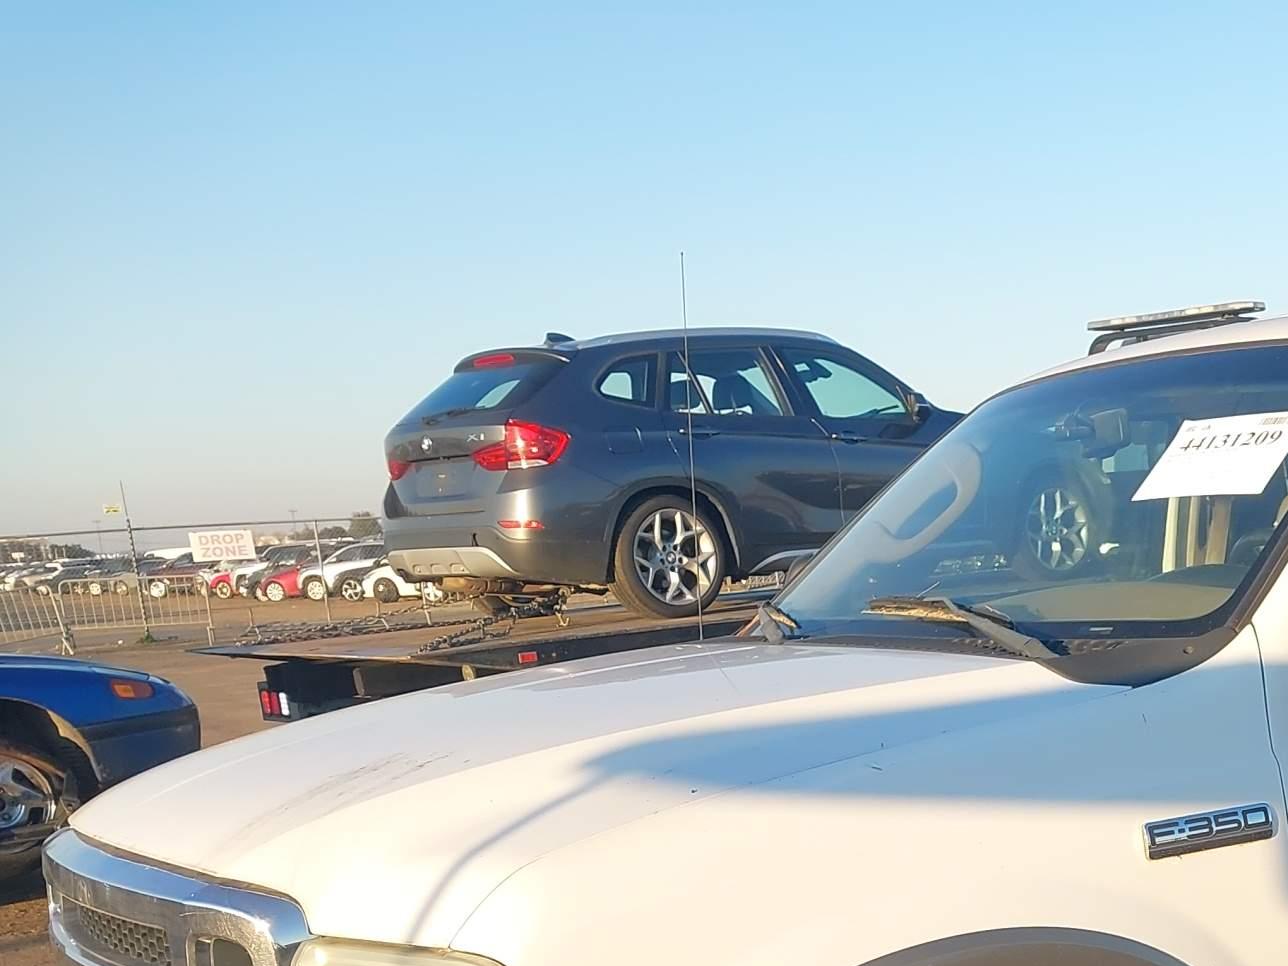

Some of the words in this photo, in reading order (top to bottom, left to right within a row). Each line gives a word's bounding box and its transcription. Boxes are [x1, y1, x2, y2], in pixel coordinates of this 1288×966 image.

[1179, 429, 1284, 452] 44131209
[197, 532, 245, 547] DROP
[199, 544, 250, 558] ZONE
[1147, 806, 1271, 847] F-350
